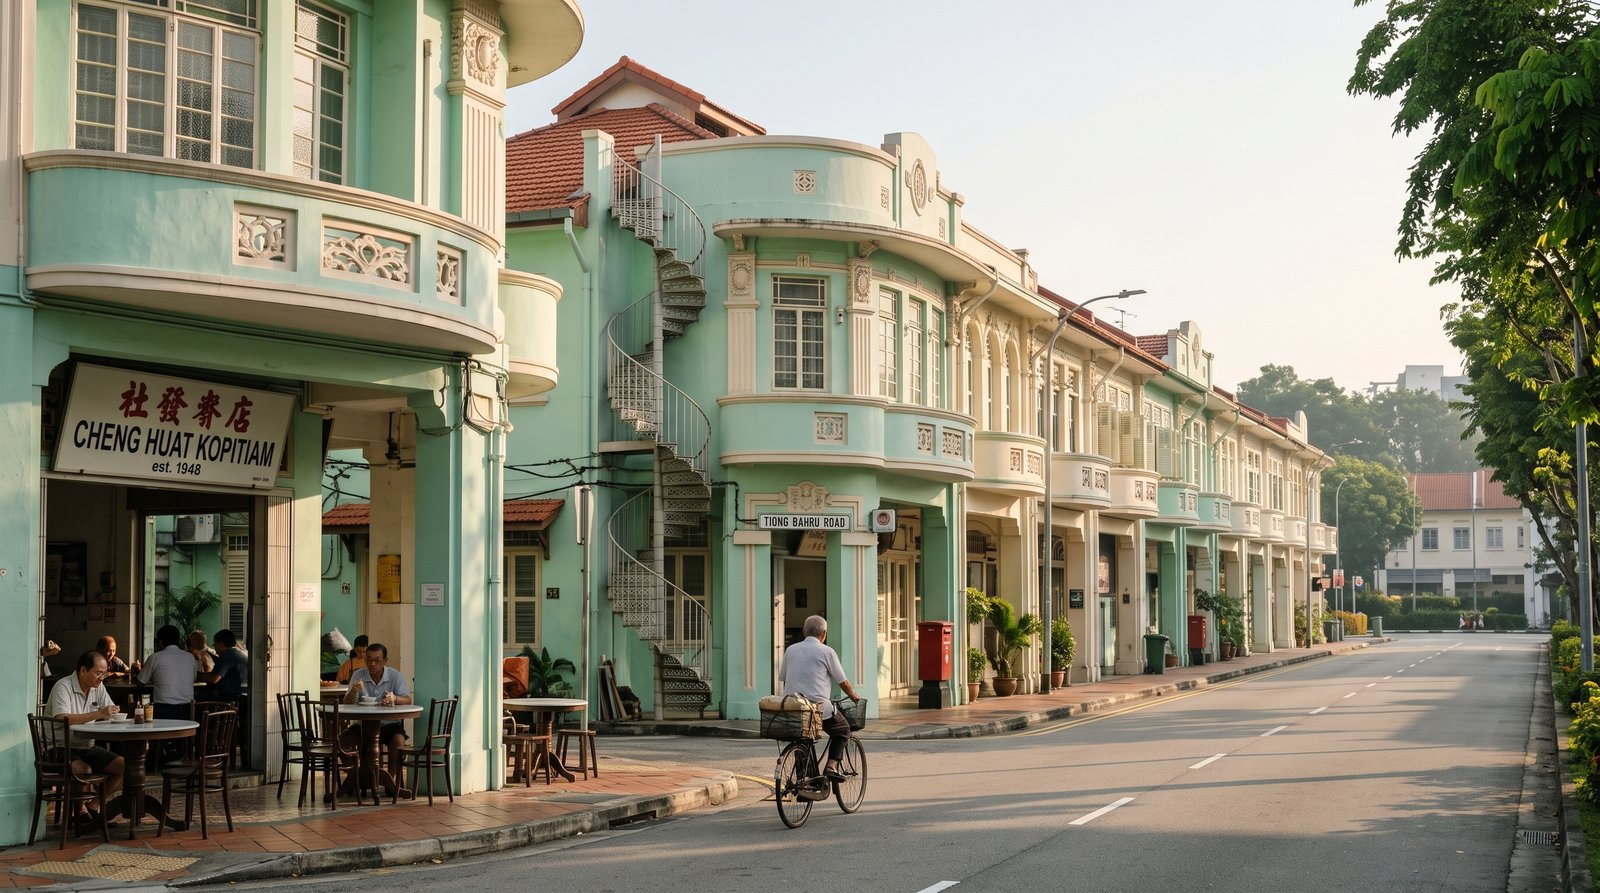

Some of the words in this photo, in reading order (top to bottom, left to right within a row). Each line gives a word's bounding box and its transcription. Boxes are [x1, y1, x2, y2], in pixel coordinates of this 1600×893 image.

[73, 419, 141, 454] CHENG
[144, 428, 194, 457] HUAT
[195, 434, 275, 467] KOPITIAM
[152, 461, 172, 473] est.
[176, 462, 202, 475] 1948
[764, 516, 789, 527] TIONG
[792, 517, 820, 527] BAHRU
[823, 517, 845, 527] ROAD
